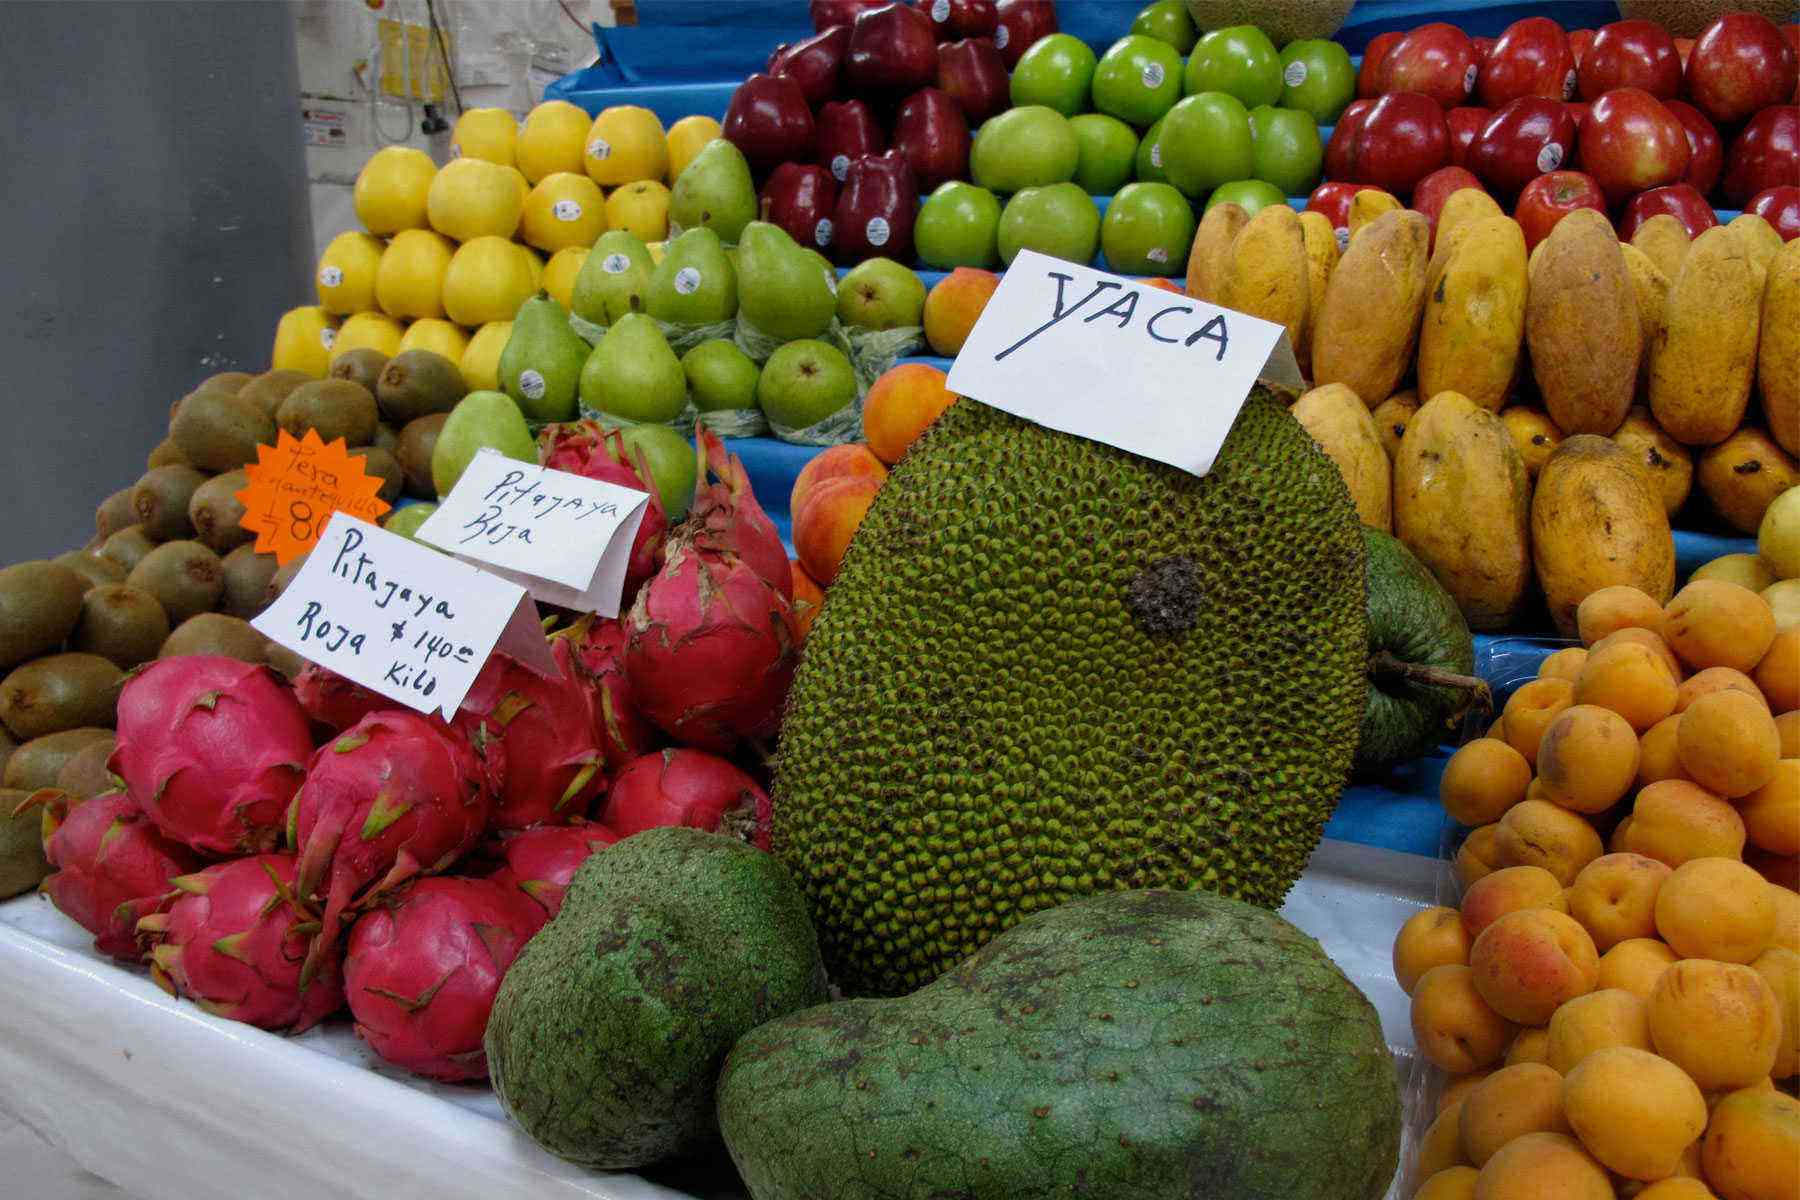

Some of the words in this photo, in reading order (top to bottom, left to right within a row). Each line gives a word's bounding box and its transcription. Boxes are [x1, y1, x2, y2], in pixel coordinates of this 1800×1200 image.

[994, 272, 1229, 362] YACA
[297, 601, 366, 655] Roja
[384, 661, 436, 696] Kilo
